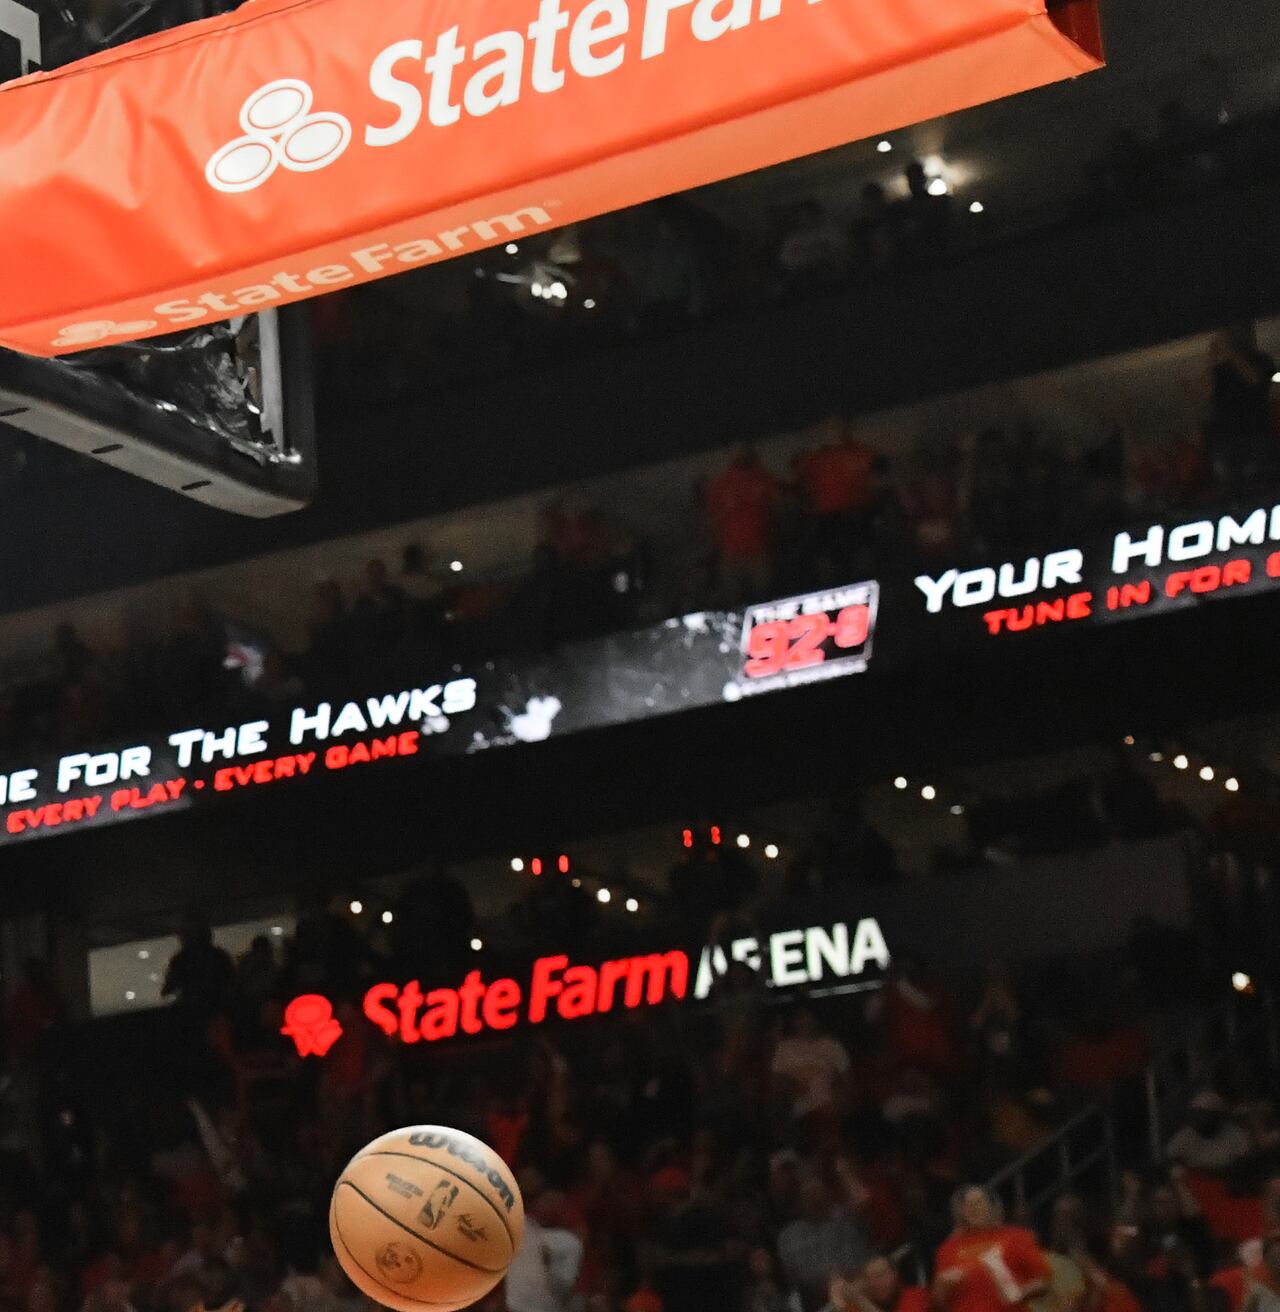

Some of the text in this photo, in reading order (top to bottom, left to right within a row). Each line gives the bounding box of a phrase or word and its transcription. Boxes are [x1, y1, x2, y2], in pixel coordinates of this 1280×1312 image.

[365, 0, 630, 147] State
[154, 201, 554, 324] State Farm
[914, 548, 1084, 613] YOUR
[983, 591, 1093, 635] TUNE
[1106, 580, 1152, 610] IN
[1165, 559, 1252, 598] FOR
[6, 795, 102, 833] EVERY
[110, 777, 187, 812] PLAY
[213, 751, 317, 792] EVERY
[324, 730, 420, 770] GAME
[56, 745, 152, 793] FOR
[168, 720, 270, 768] THE
[289, 677, 477, 745] HAWKS
[363, 966, 521, 1043] State
[528, 950, 688, 1022] Farm
